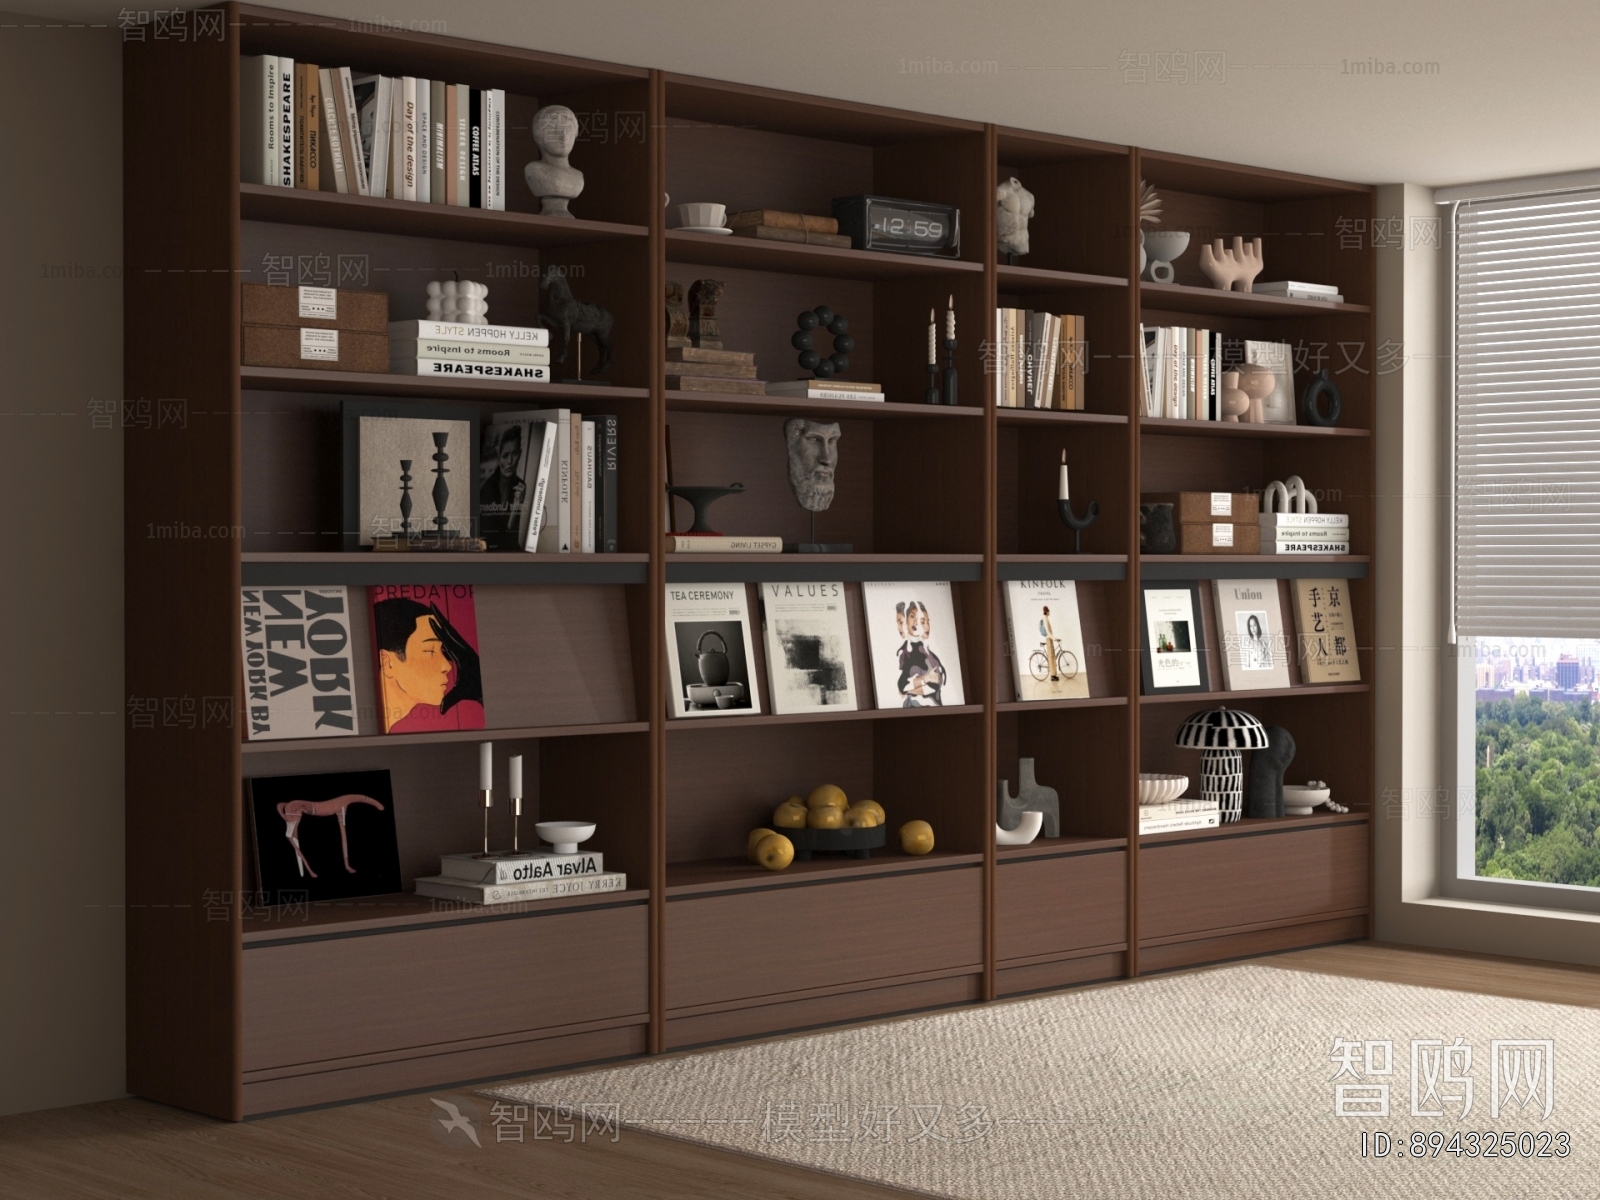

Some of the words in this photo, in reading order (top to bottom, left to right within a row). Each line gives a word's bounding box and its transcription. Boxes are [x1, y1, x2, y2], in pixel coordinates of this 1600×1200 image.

[269, 104, 275, 113] to
[405, 101, 414, 119] Day
[283, 73, 291, 186] SHAKESPEARE
[324, 97, 338, 132] СПАСИТЕ
[331, 134, 344, 172] КОТИКА!
[407, 123, 414, 135] of
[472, 126, 480, 152] COFFEE
[436, 122, 444, 170] MINIMALISM
[405, 154, 414, 187] design
[472, 154, 480, 176] ATLAS
[771, 584, 838, 597] VALUES
[1020, 580, 1066, 588] KINFOLK
[1234, 588, 1263, 600] Union
[670, 591, 687, 600] TEA
[688, 591, 734, 600] CEREMONY
[1309, 587, 1328, 656] 手艺人
[1327, 586, 1347, 656] 京都
